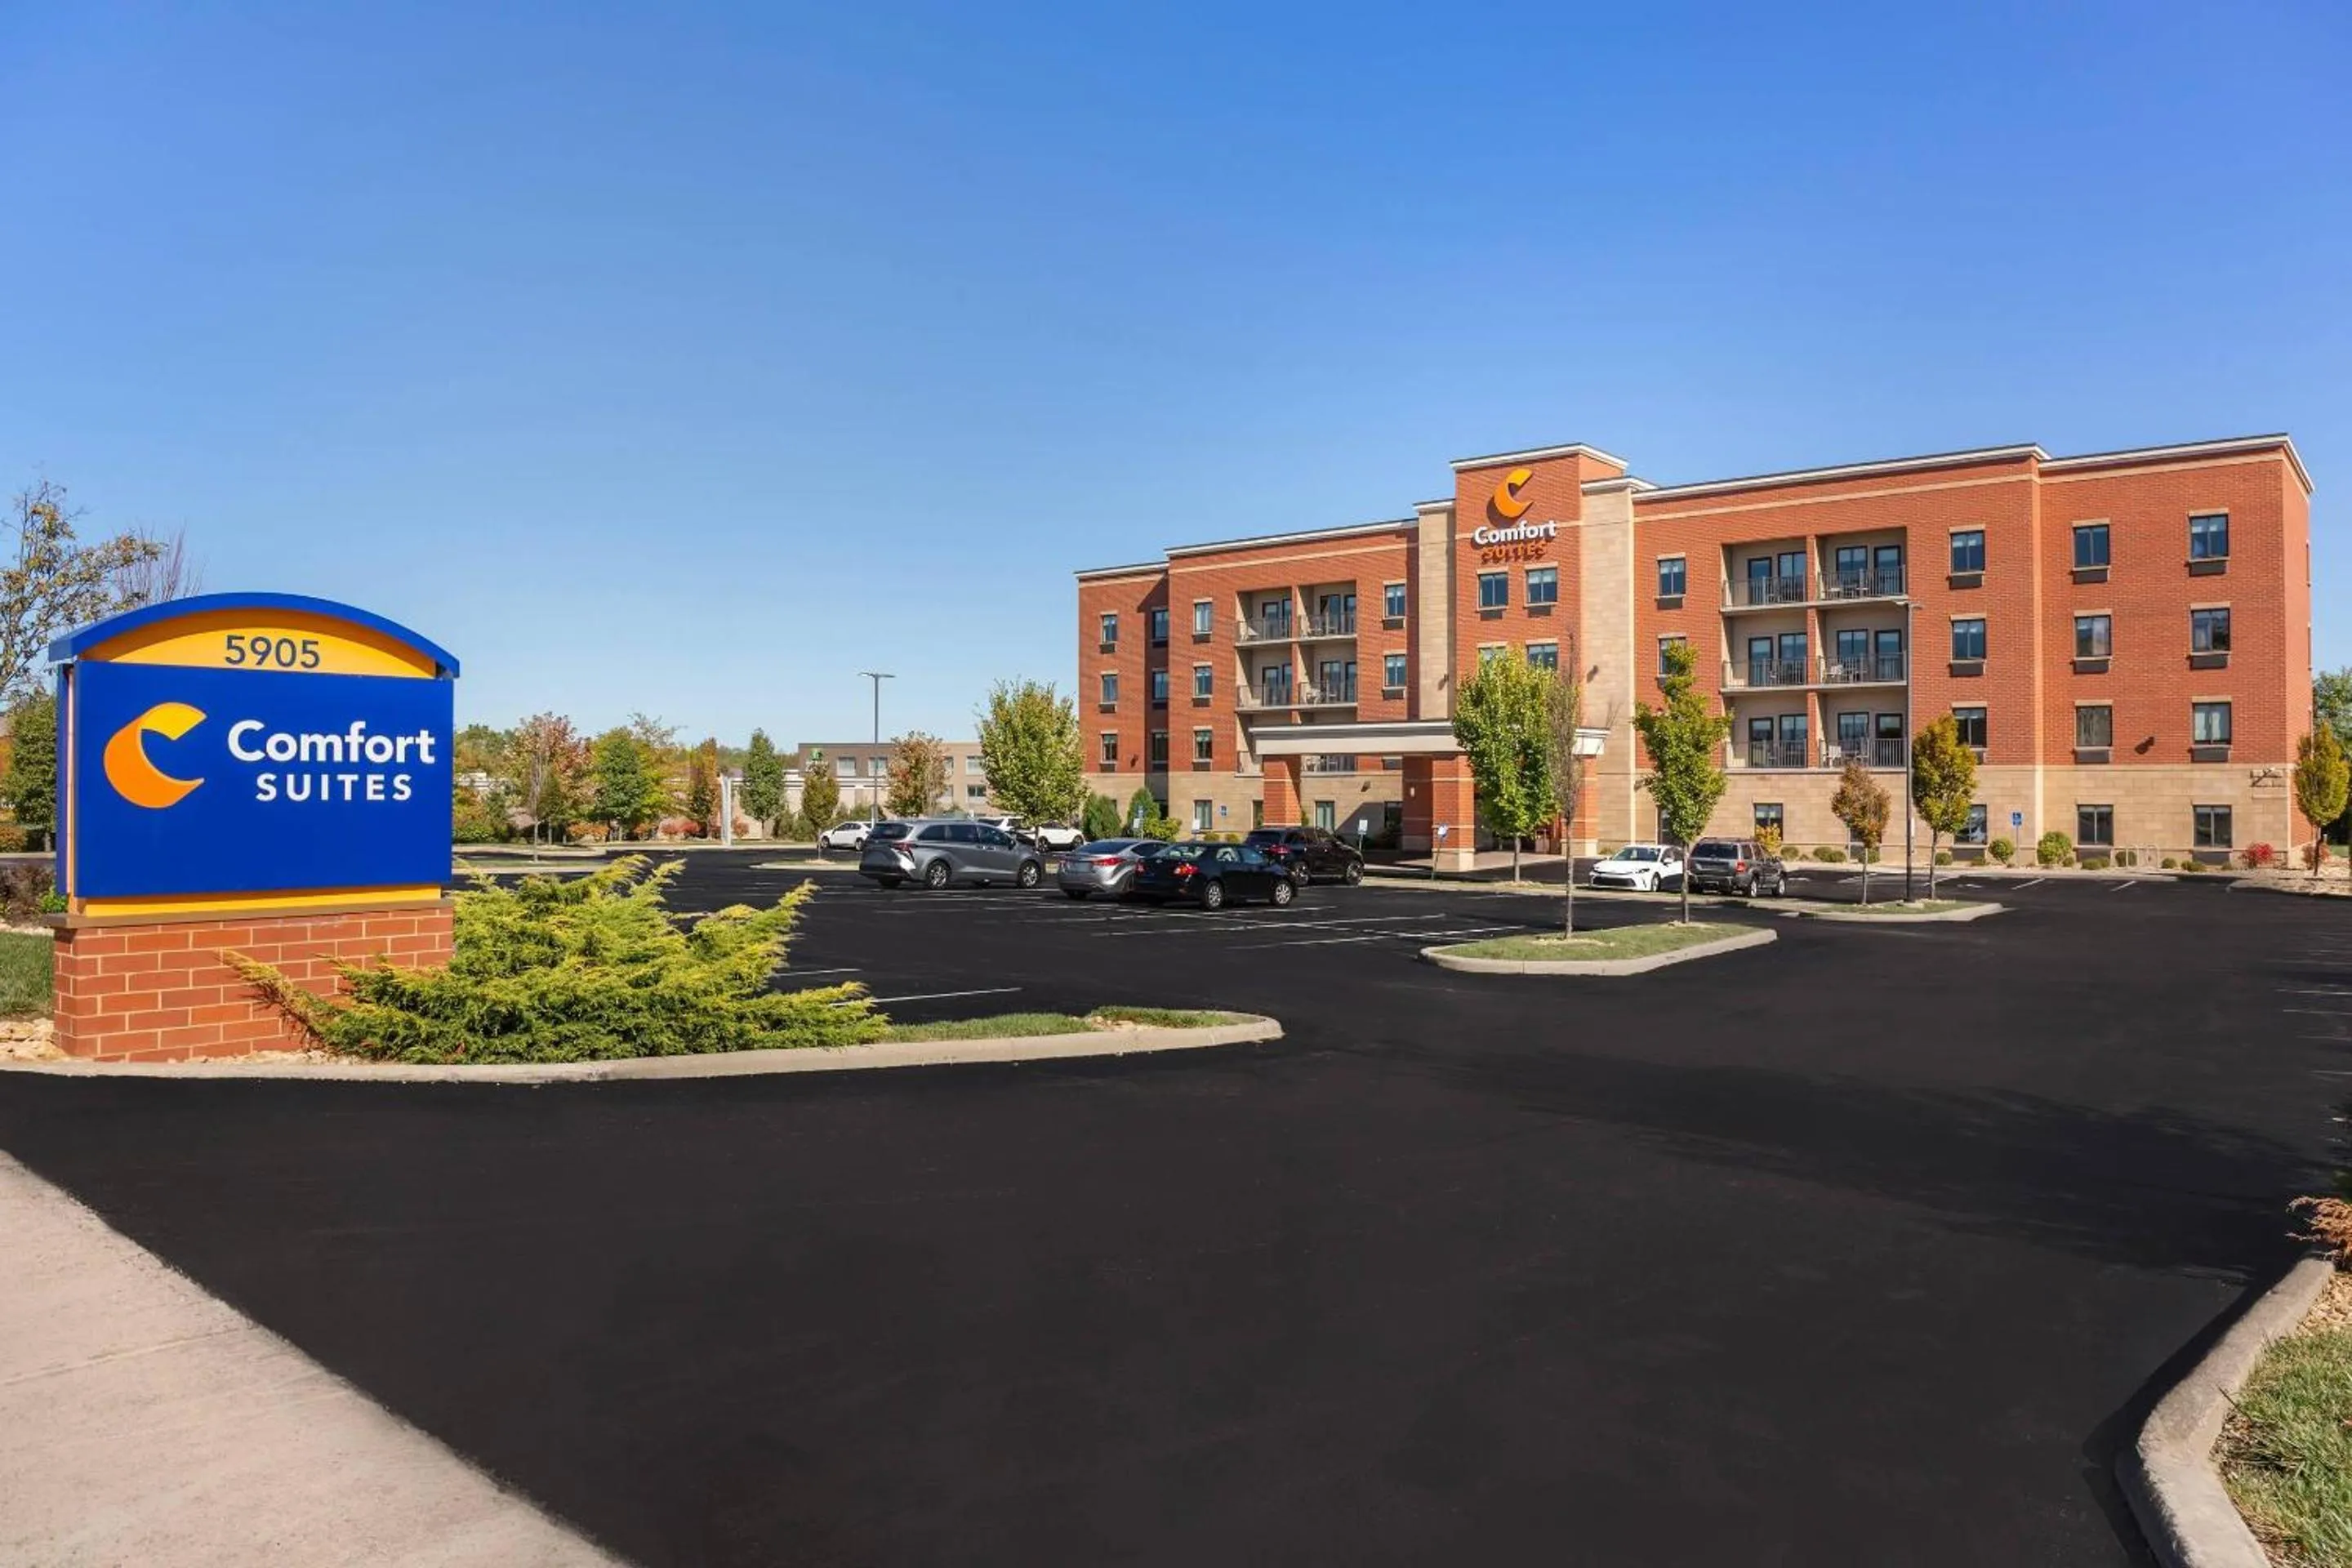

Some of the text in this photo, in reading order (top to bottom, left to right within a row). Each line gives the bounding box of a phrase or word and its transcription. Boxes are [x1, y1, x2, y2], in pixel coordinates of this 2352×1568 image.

[1474, 520, 1556, 545] Comfort
[1483, 540, 1547, 559] SUITES
[225, 635, 320, 668] 5905
[228, 719, 435, 764] Comfort
[256, 773, 412, 802] SUITES
